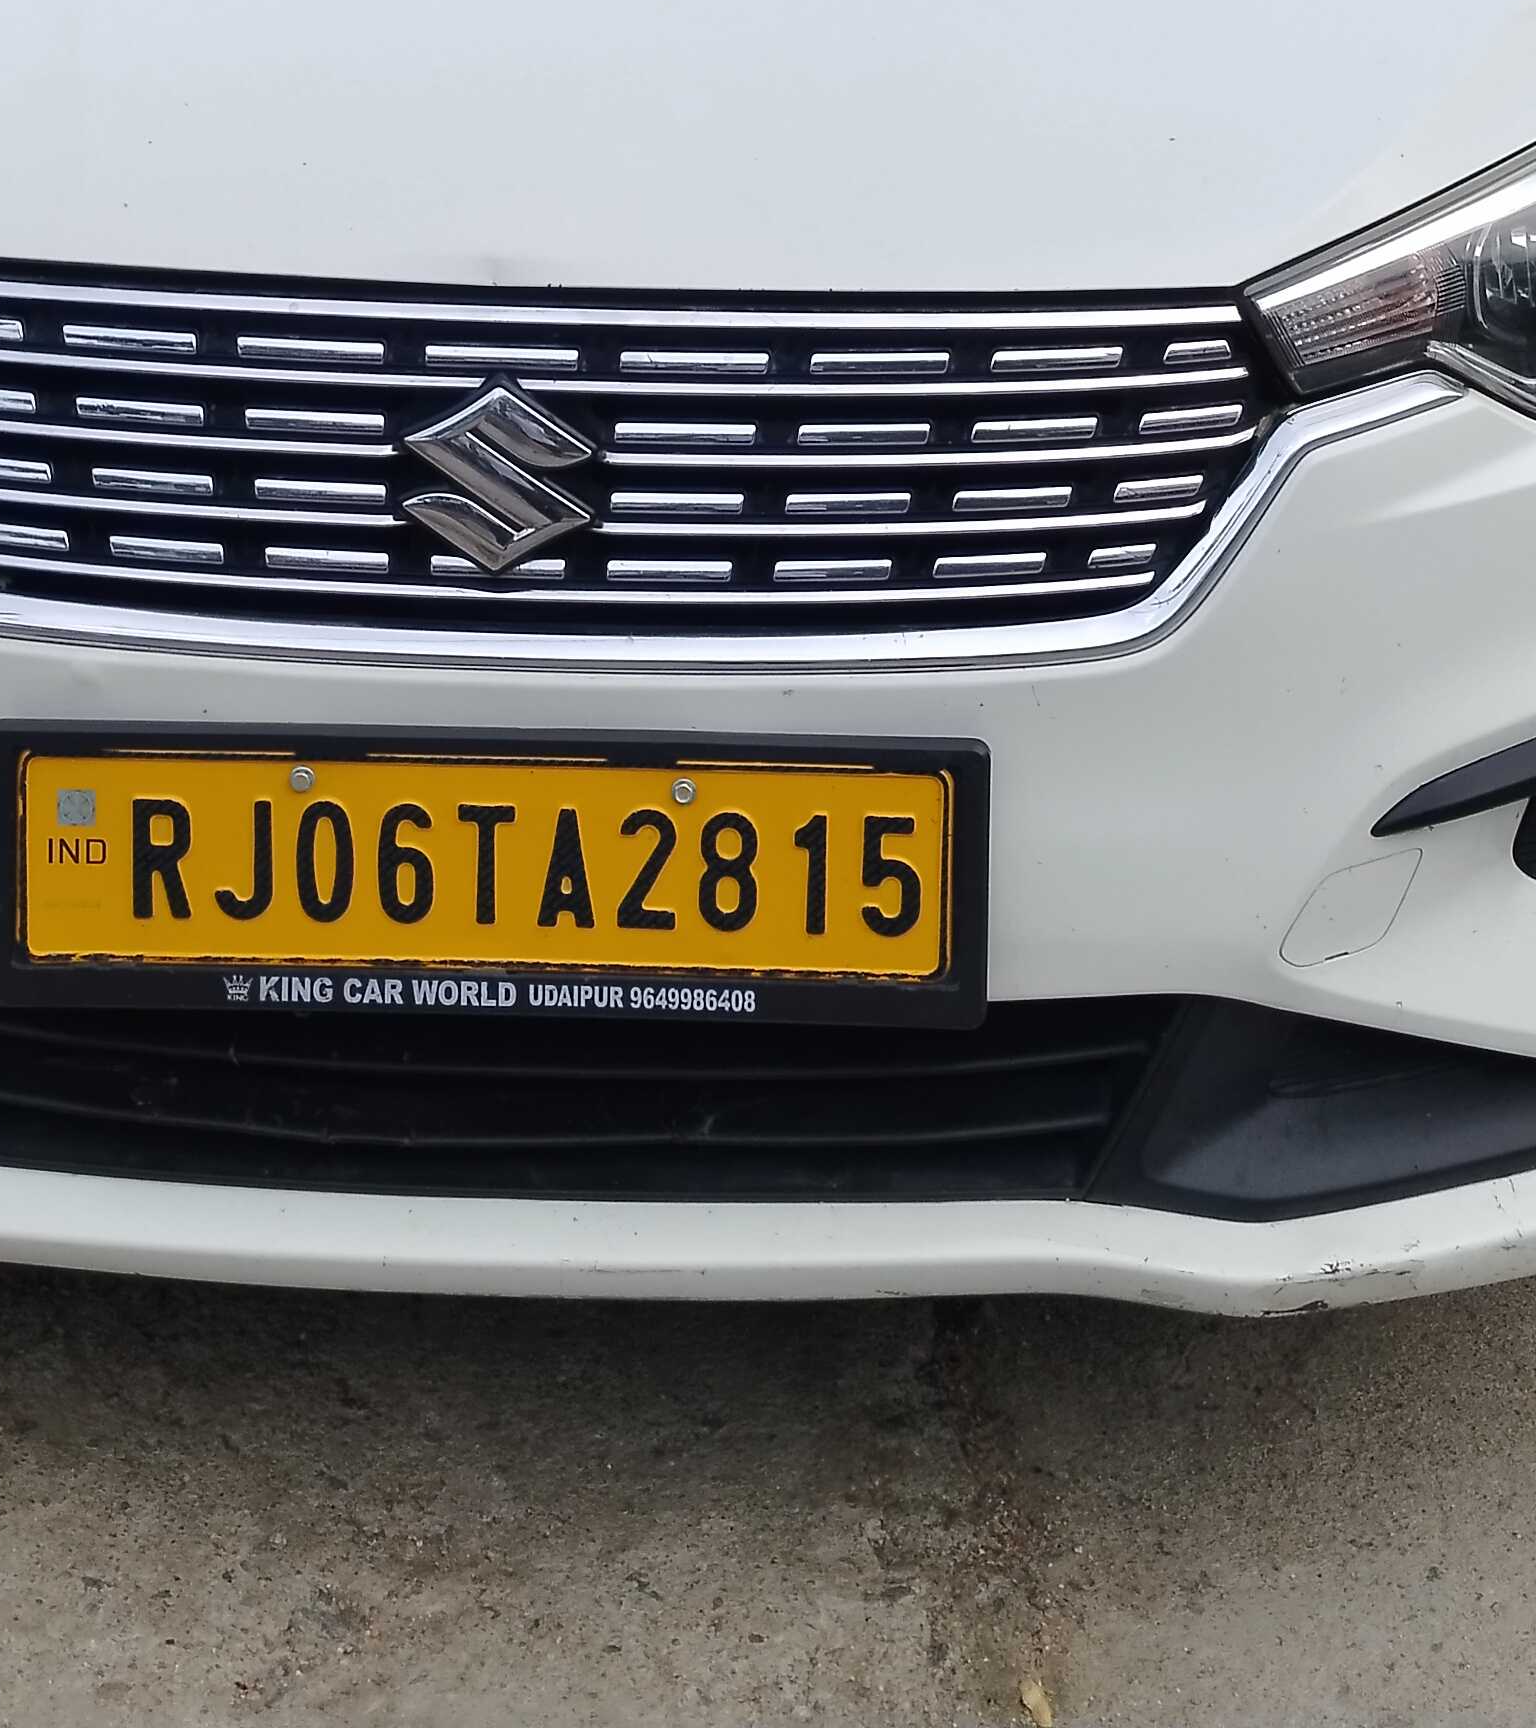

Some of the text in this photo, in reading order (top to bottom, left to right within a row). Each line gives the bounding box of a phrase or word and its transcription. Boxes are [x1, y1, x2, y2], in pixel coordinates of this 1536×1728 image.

[47, 838, 107, 865] IND
[131, 798, 923, 938] RJ06TA2815
[259, 975, 757, 1013] KING CAR WORLD UDAIPUR 9649986408
